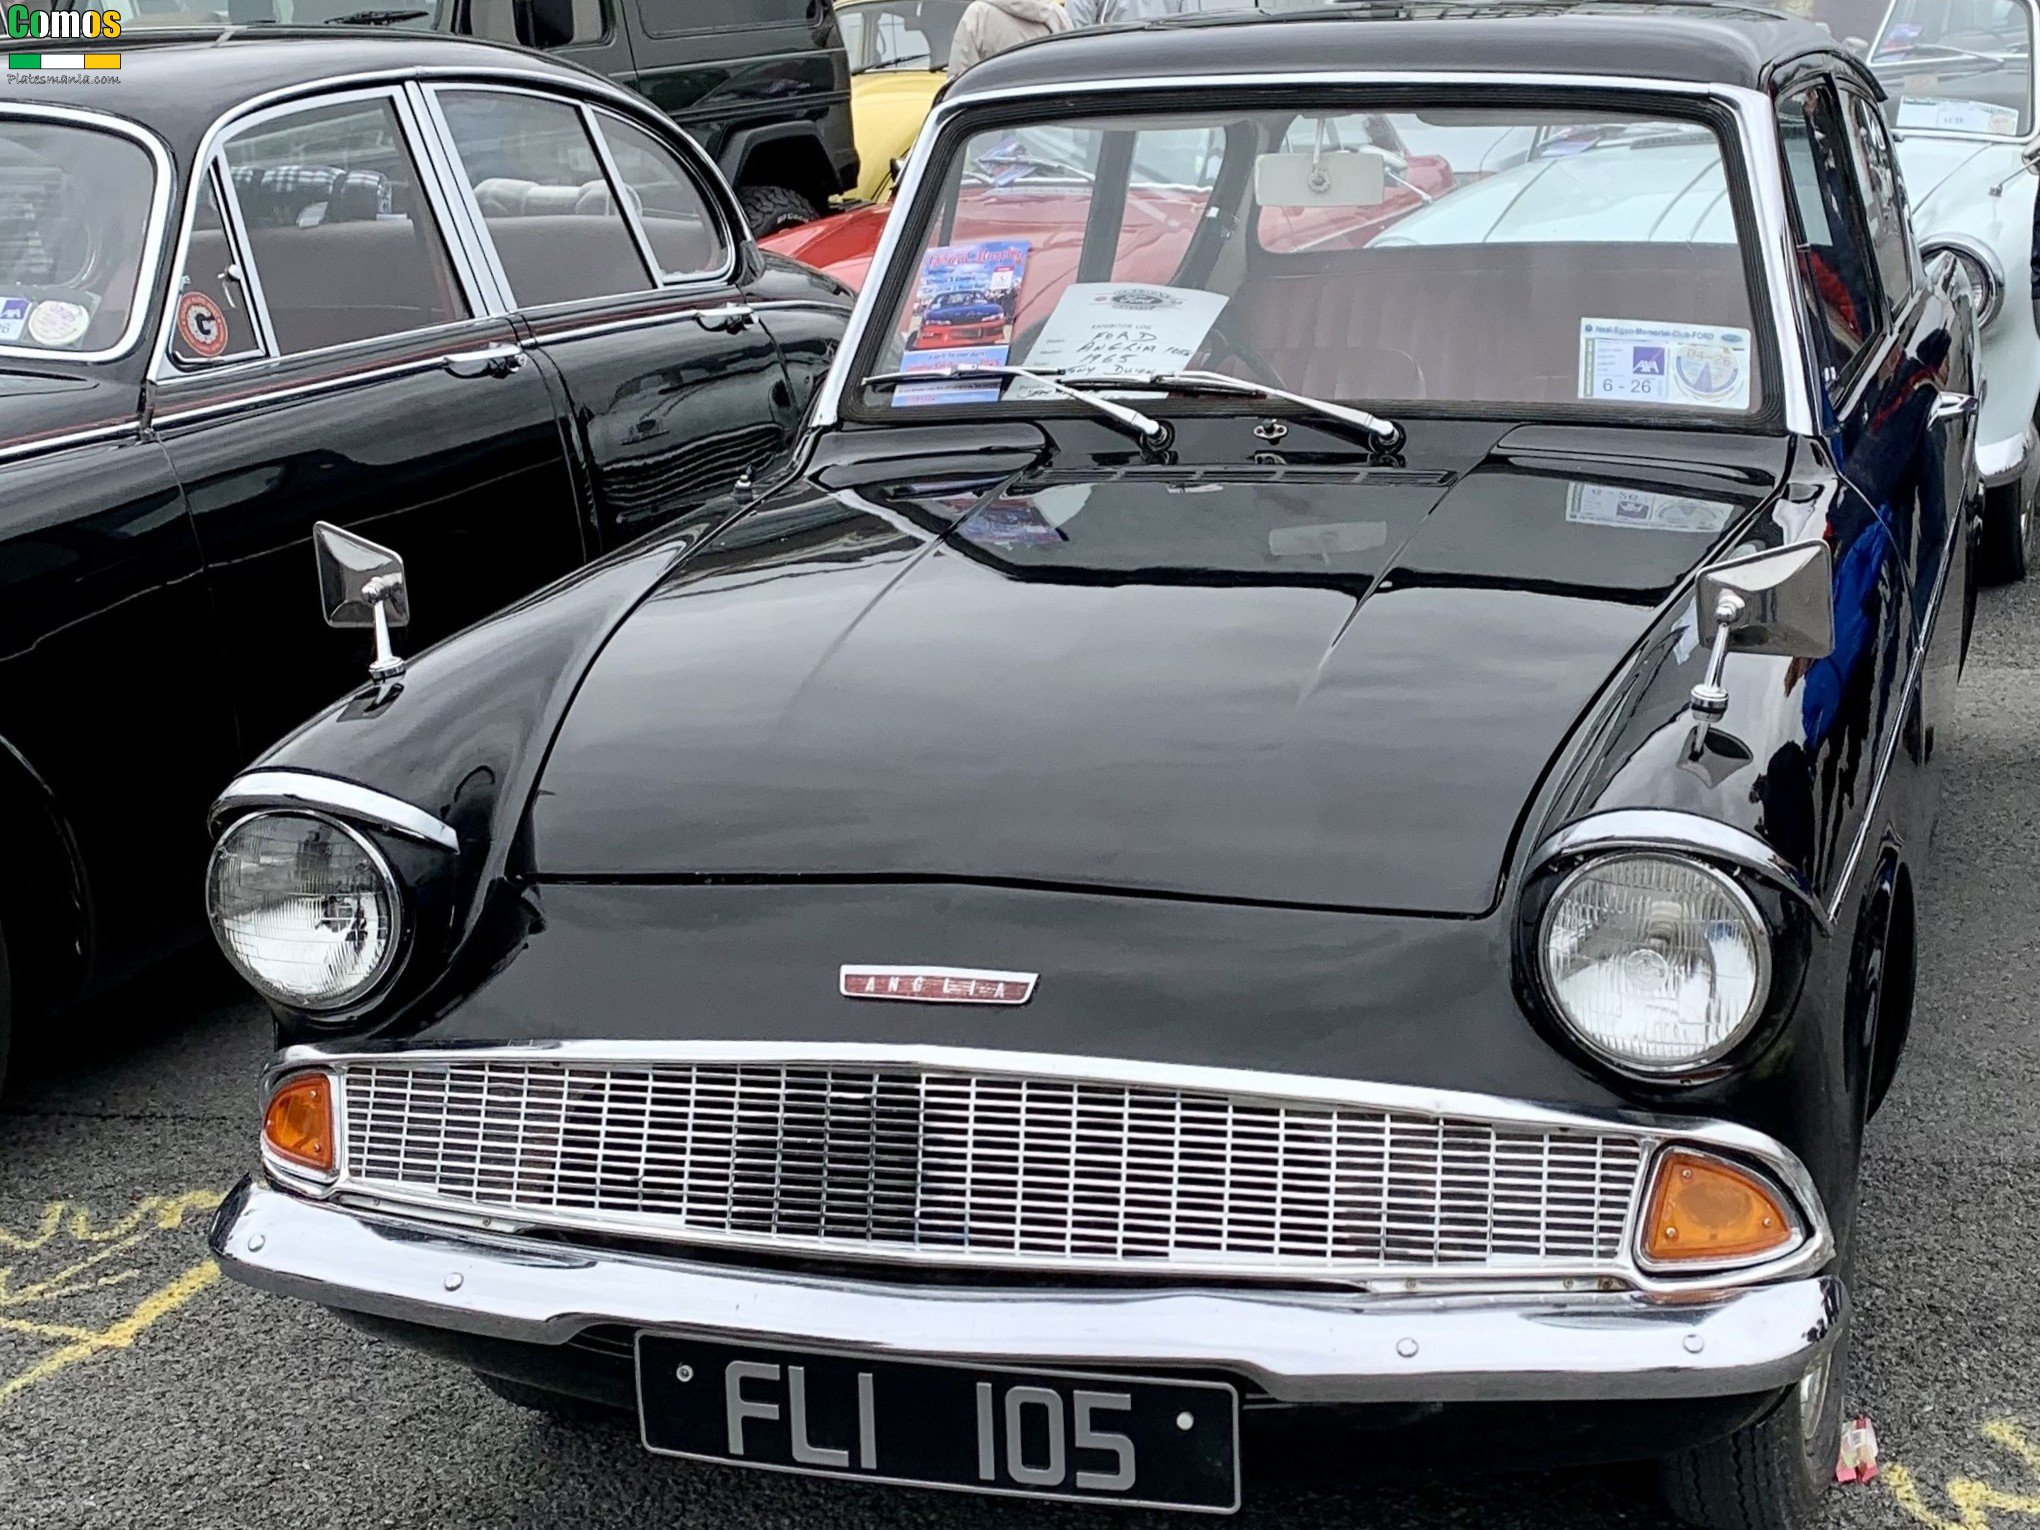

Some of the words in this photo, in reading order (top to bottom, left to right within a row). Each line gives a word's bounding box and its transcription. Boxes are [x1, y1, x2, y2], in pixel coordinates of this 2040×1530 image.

[1080, 353, 1137, 365] 1965
[1633, 359, 1660, 374] AXA
[1603, 378, 1613, 392] 6
[1630, 380, 1652, 394] 26
[864, 975, 1005, 999] ANGLIA
[724, 1359, 877, 1470] FLI
[975, 1381, 1136, 1491] 105
